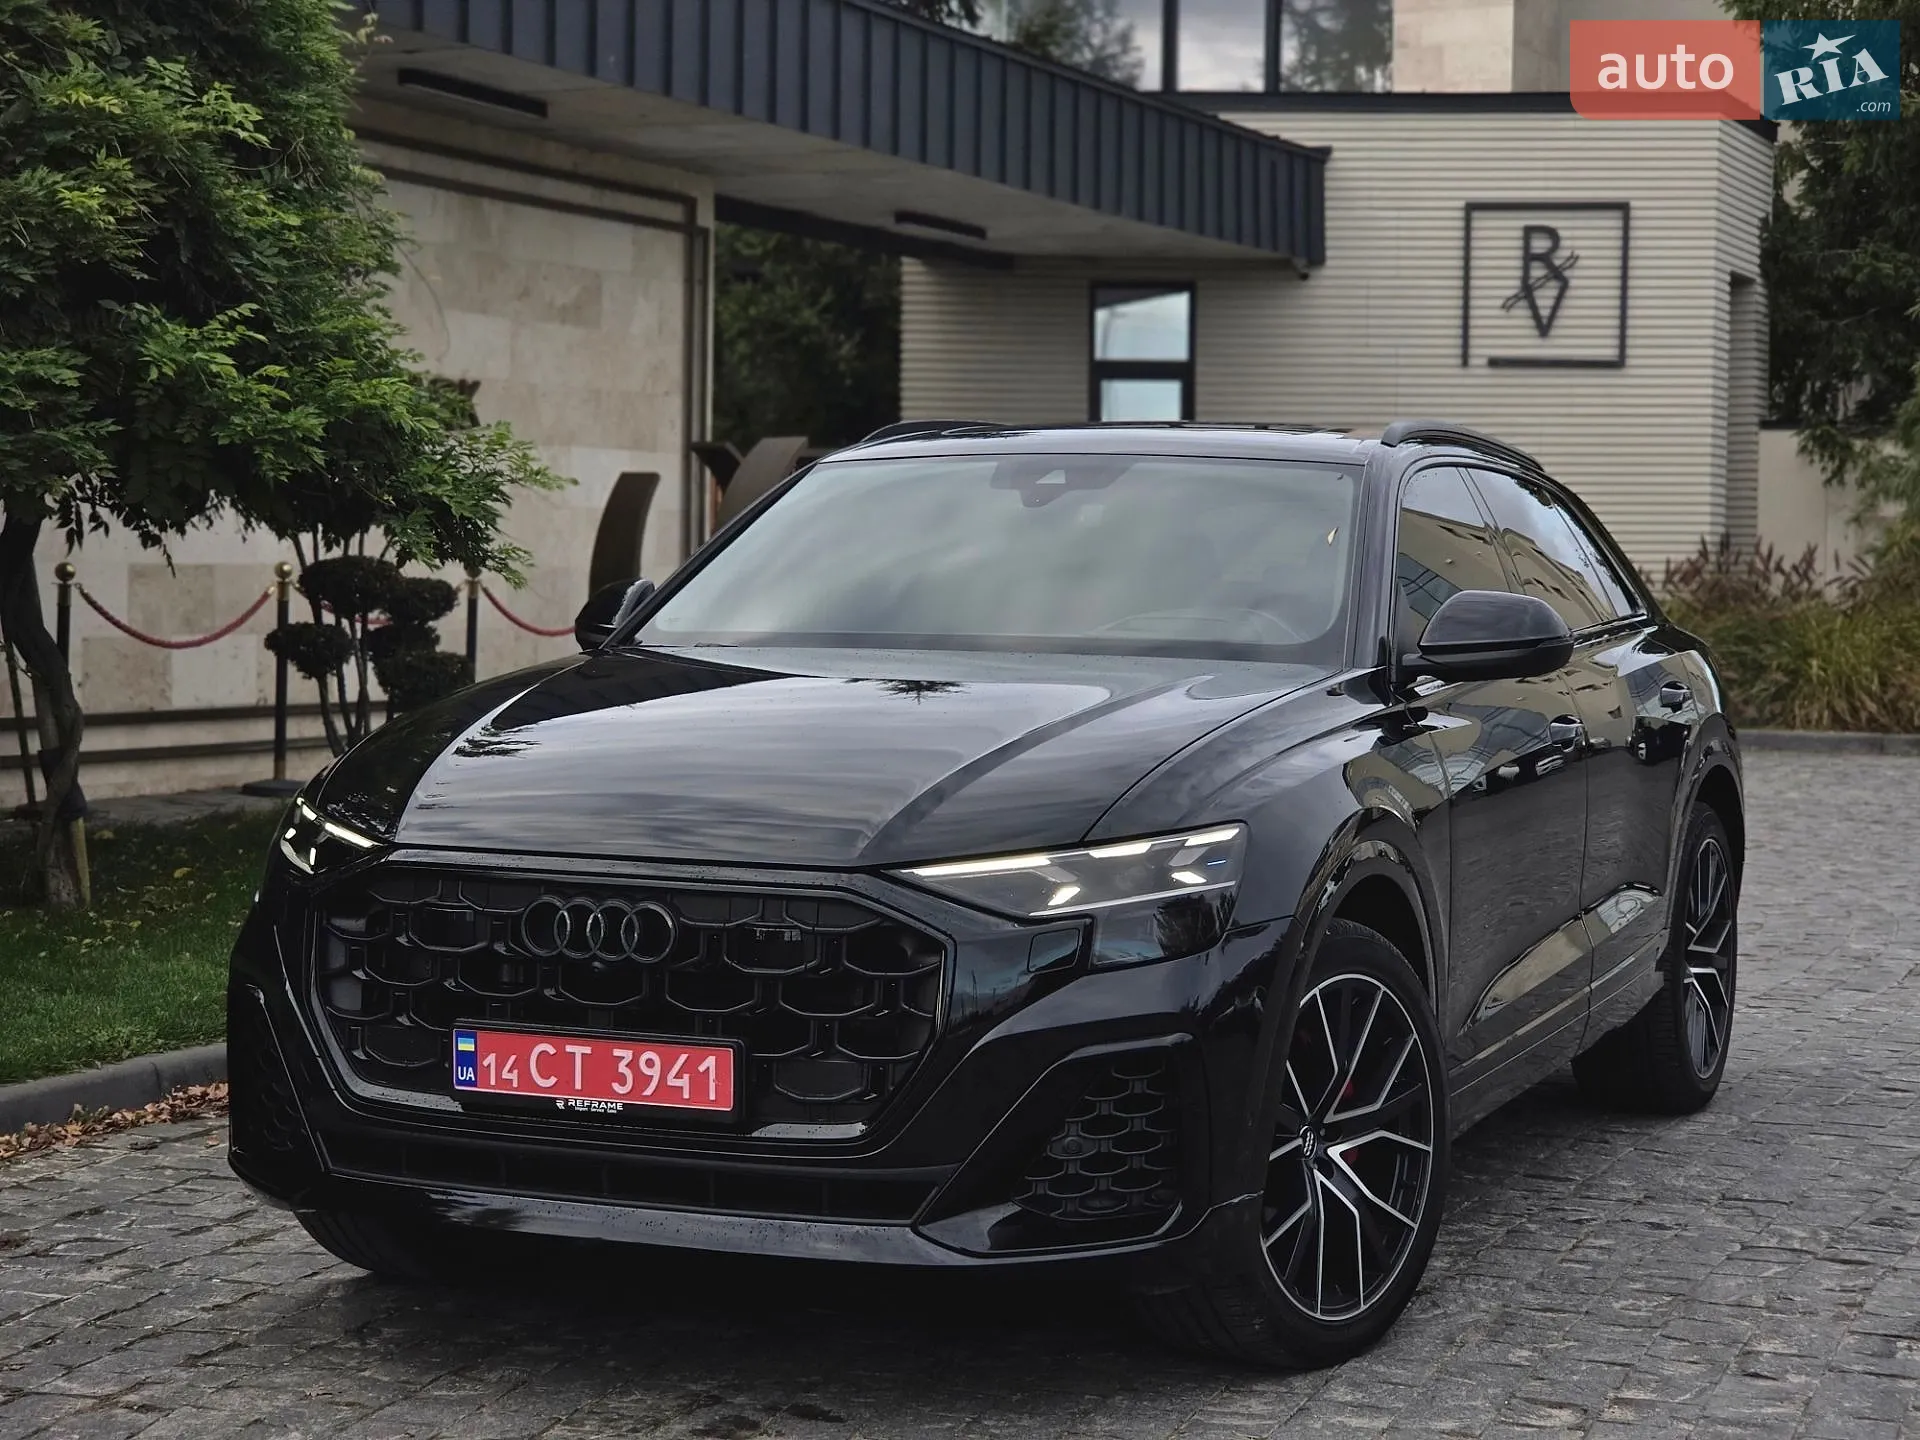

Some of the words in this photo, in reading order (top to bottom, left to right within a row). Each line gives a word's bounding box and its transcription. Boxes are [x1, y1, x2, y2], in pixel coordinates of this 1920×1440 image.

[457, 1066, 475, 1081] UA
[611, 1048, 717, 1100] 3941
[567, 1099, 624, 1111] REFRAME
